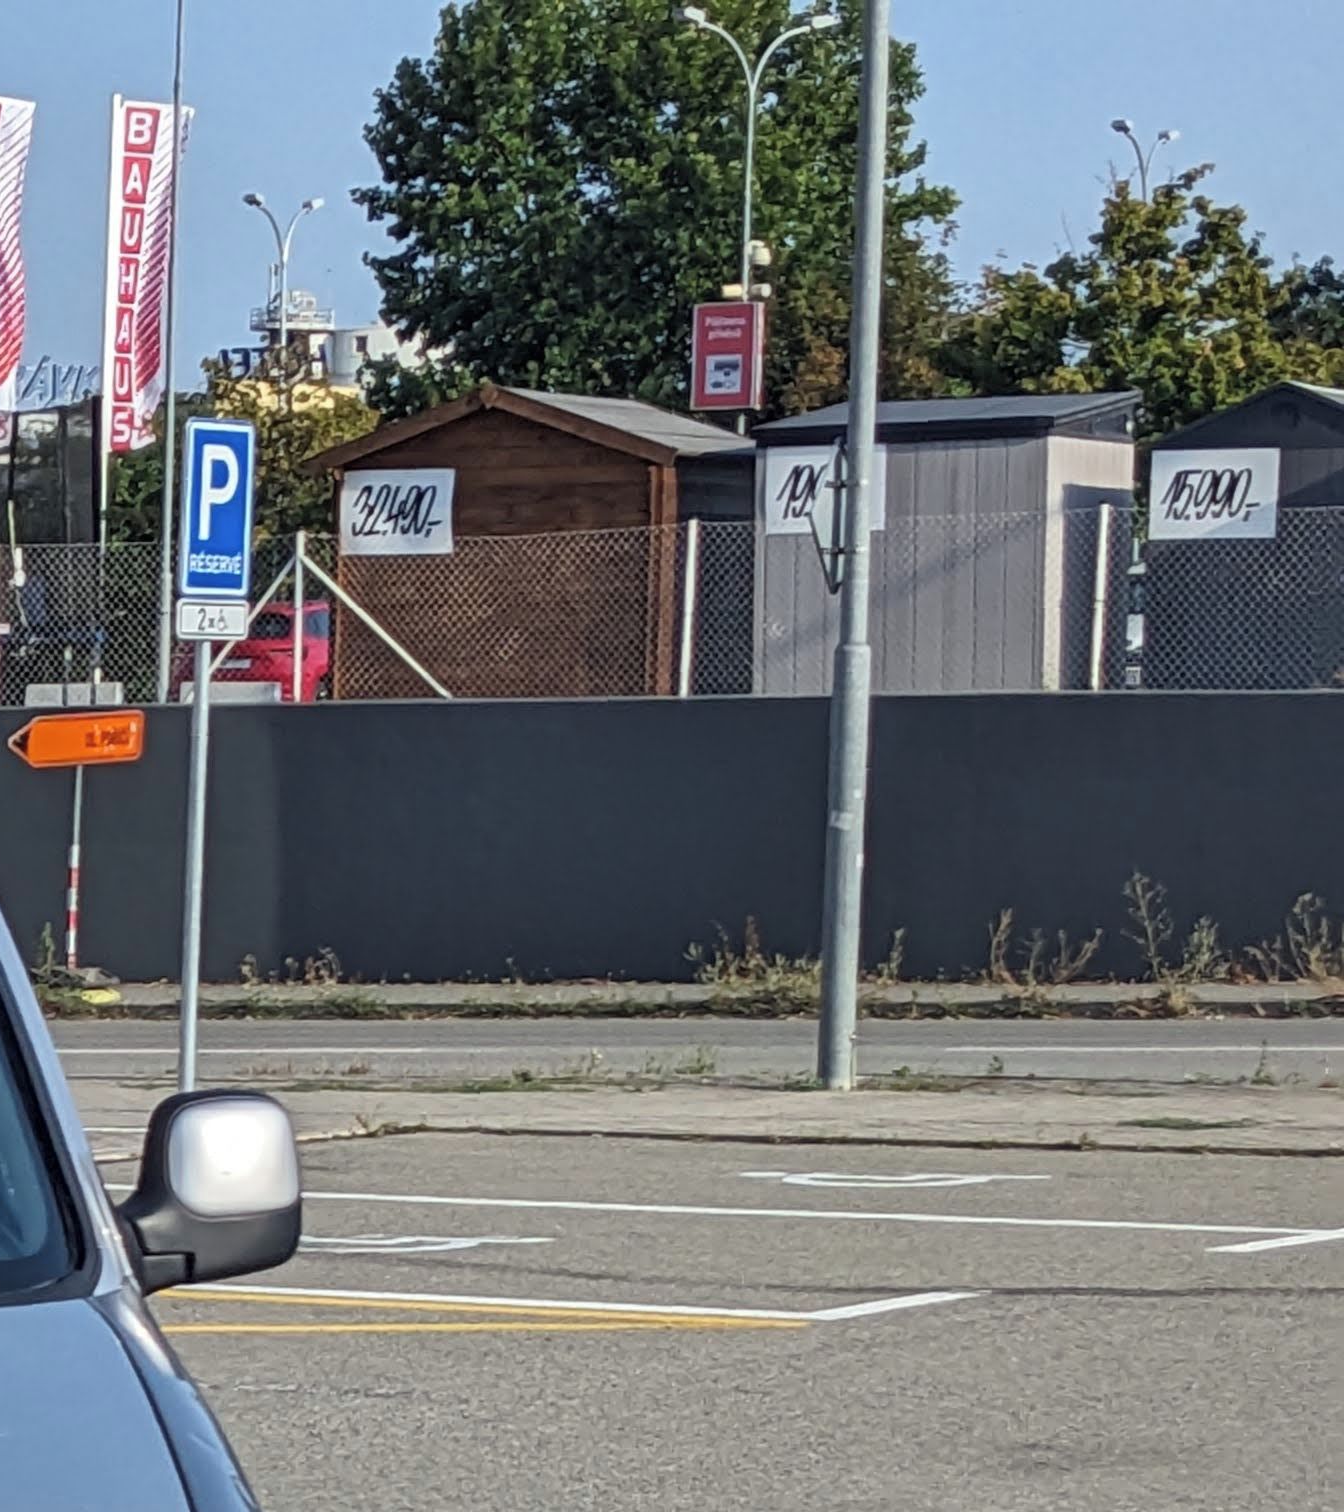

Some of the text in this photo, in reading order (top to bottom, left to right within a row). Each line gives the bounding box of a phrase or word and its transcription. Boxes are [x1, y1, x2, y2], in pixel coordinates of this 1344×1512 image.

[113, 110, 152, 444] BAUHAUS
[198, 443, 239, 541] P
[189, 550, 242, 575] RÉSERVÉ
